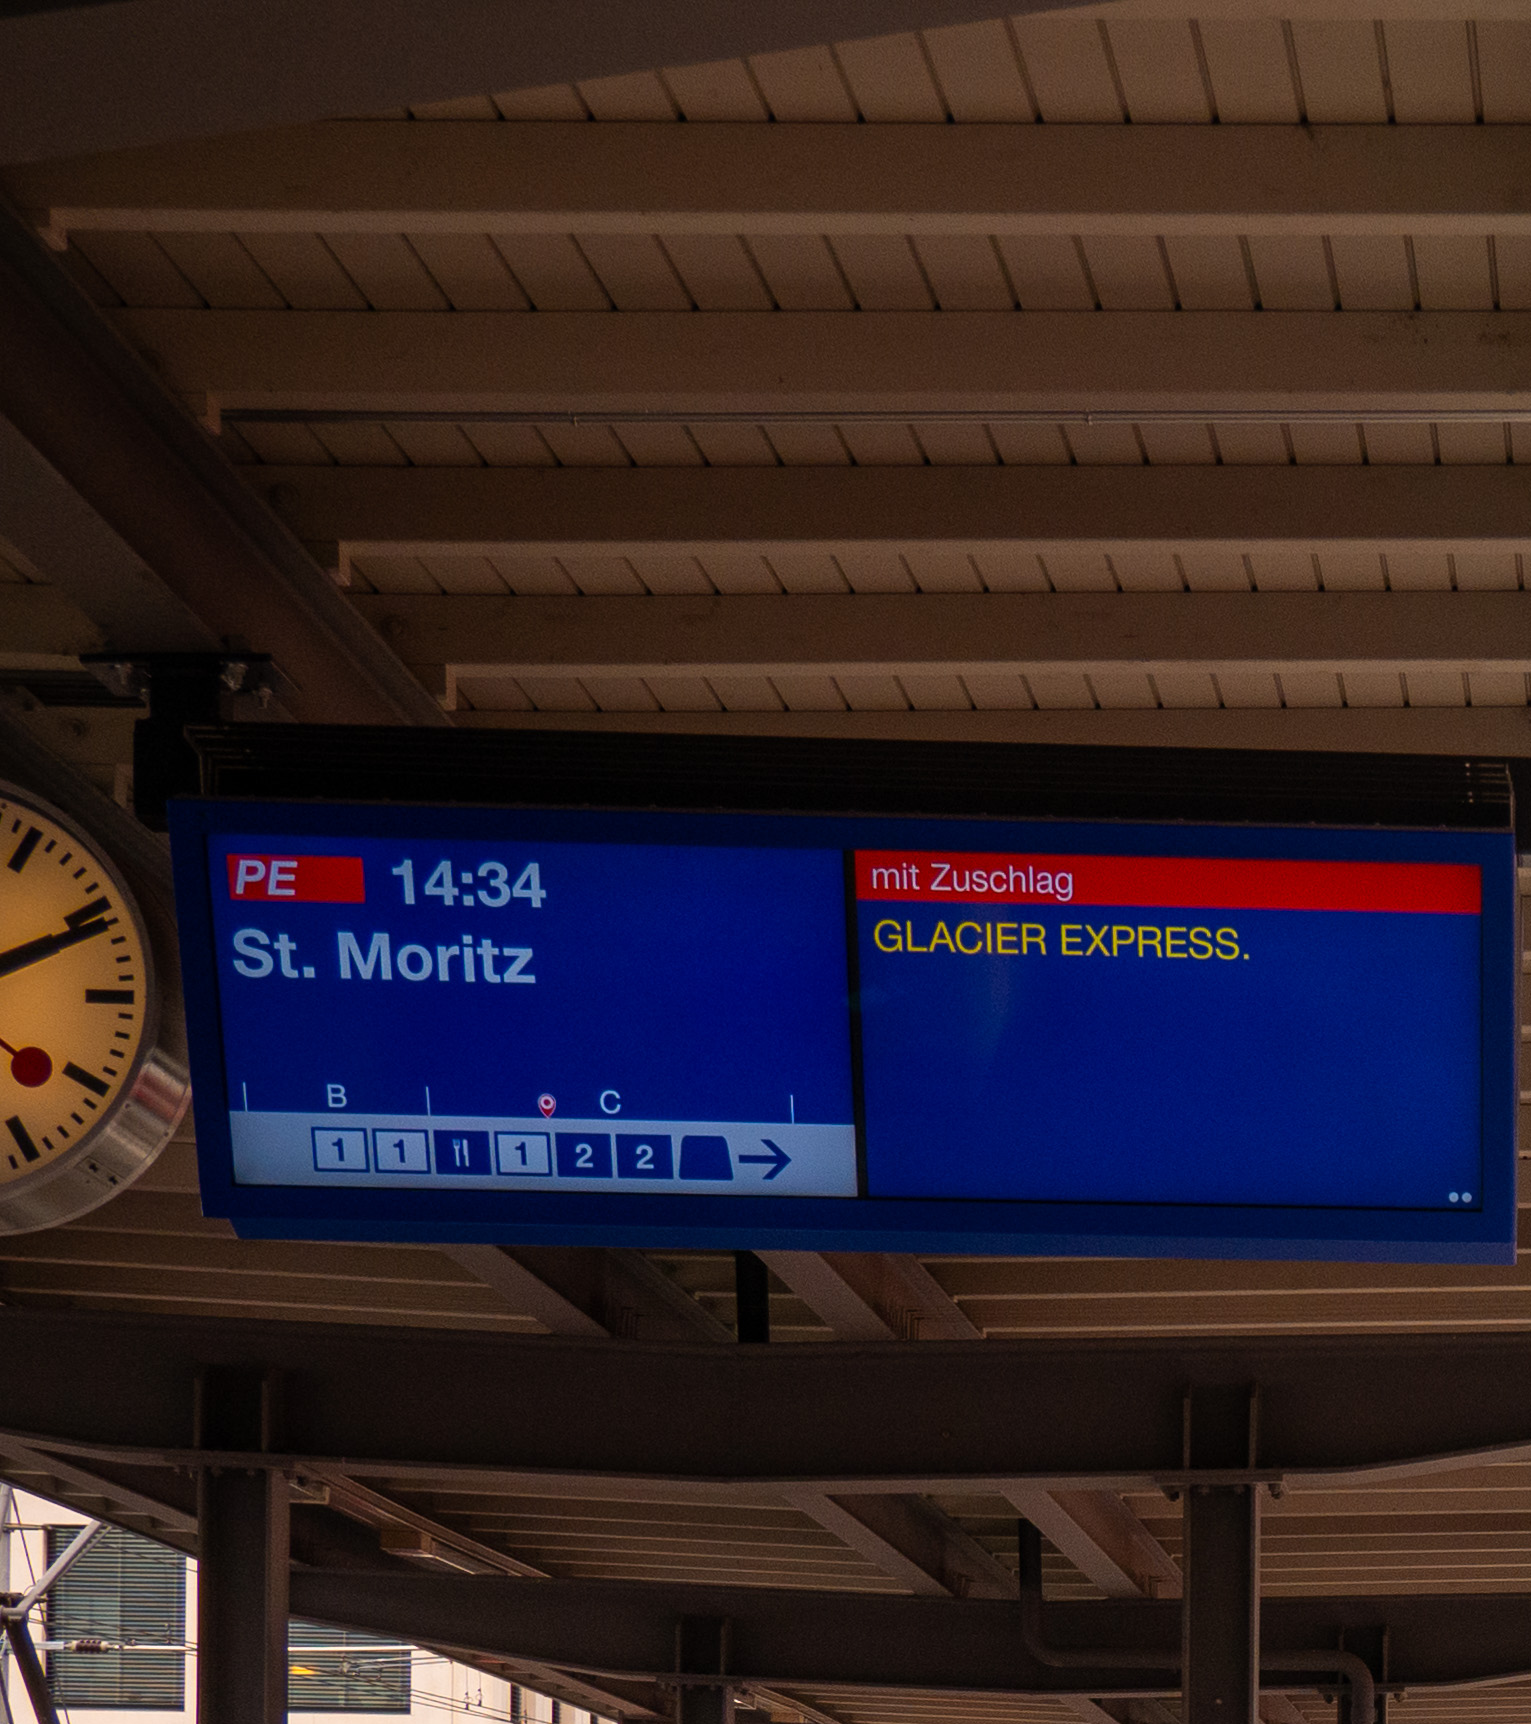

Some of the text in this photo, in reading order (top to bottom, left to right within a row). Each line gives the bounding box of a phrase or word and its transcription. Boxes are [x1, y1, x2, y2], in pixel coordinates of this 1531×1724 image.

[235, 860, 298, 896] PE
[391, 860, 547, 908] 14:34
[871, 864, 1074, 901] mit Zuschlag
[233, 928, 536, 984] St. Moritz
[873, 920, 1251, 960] GLACIER EXPRESS.
[327, 1084, 622, 1114] B C
[332, 1138, 654, 1170] 1 1 1 2 2
